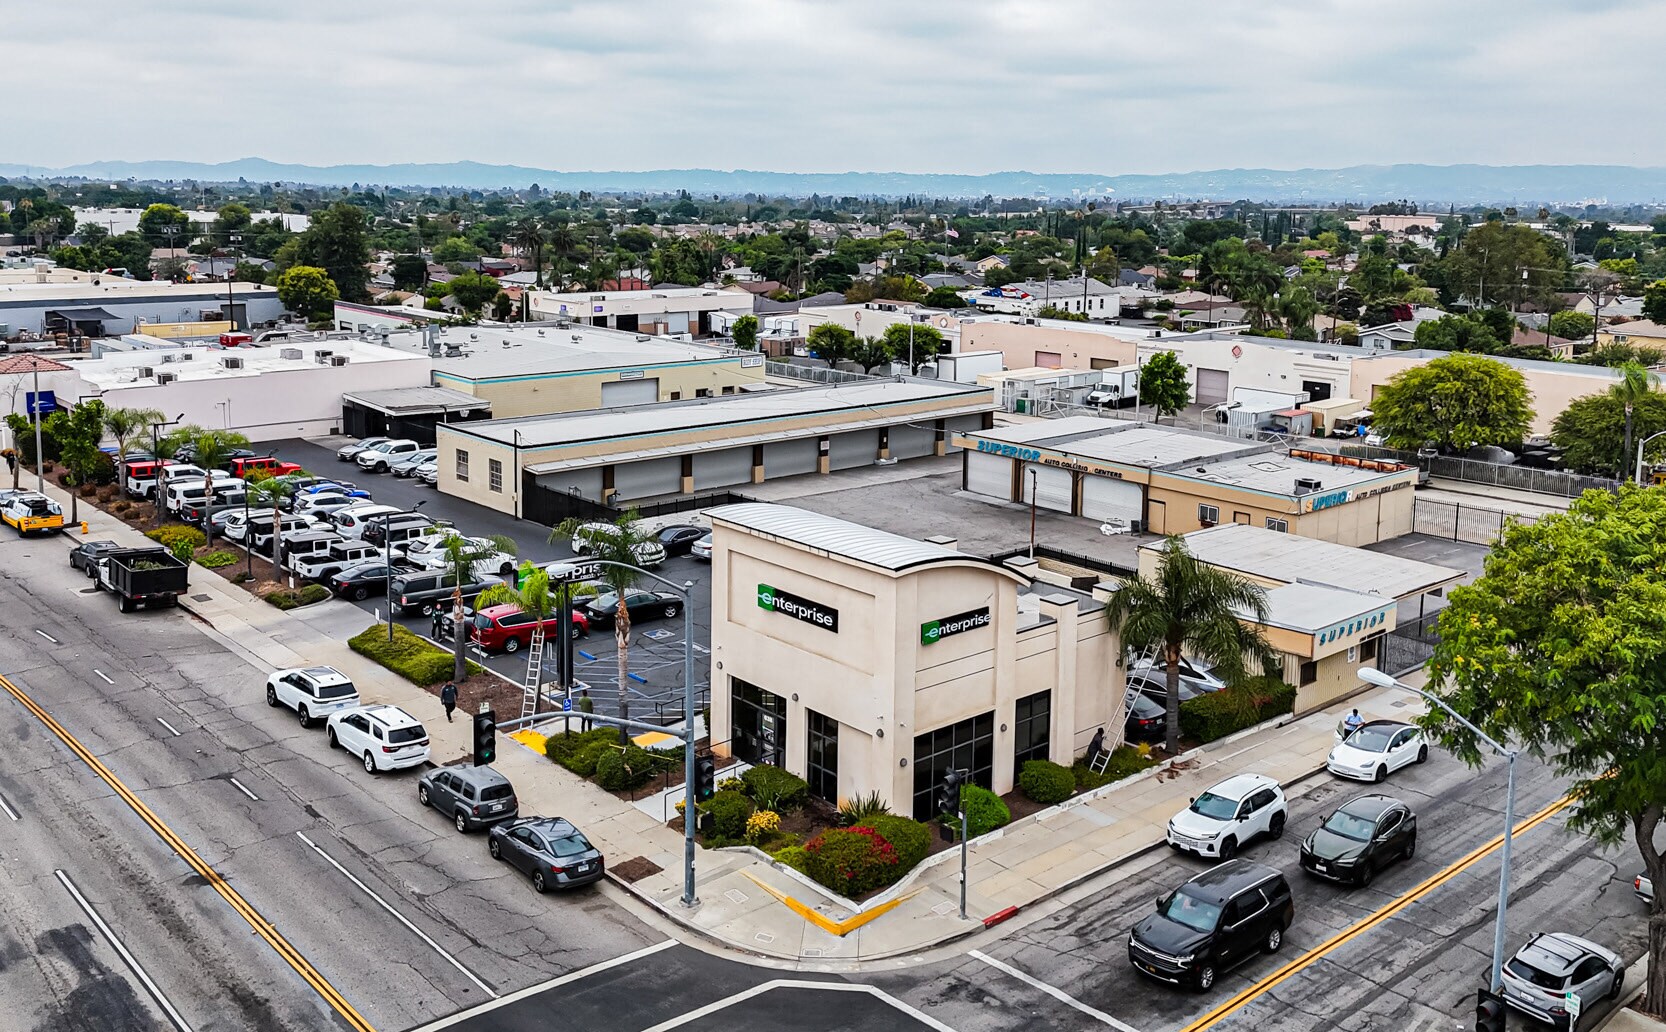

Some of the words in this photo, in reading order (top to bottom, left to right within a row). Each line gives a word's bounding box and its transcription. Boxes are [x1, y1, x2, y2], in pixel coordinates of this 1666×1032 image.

[977, 440, 1041, 461] SUPERIOR
[1043, 458, 1060, 467] AUTO
[1094, 468, 1123, 479] CENTERS
[1305, 489, 1353, 513] SUPERIOR
[758, 592, 834, 627] enterprise
[925, 613, 992, 638] enterprise
[1319, 611, 1386, 646] SUPERIOR
